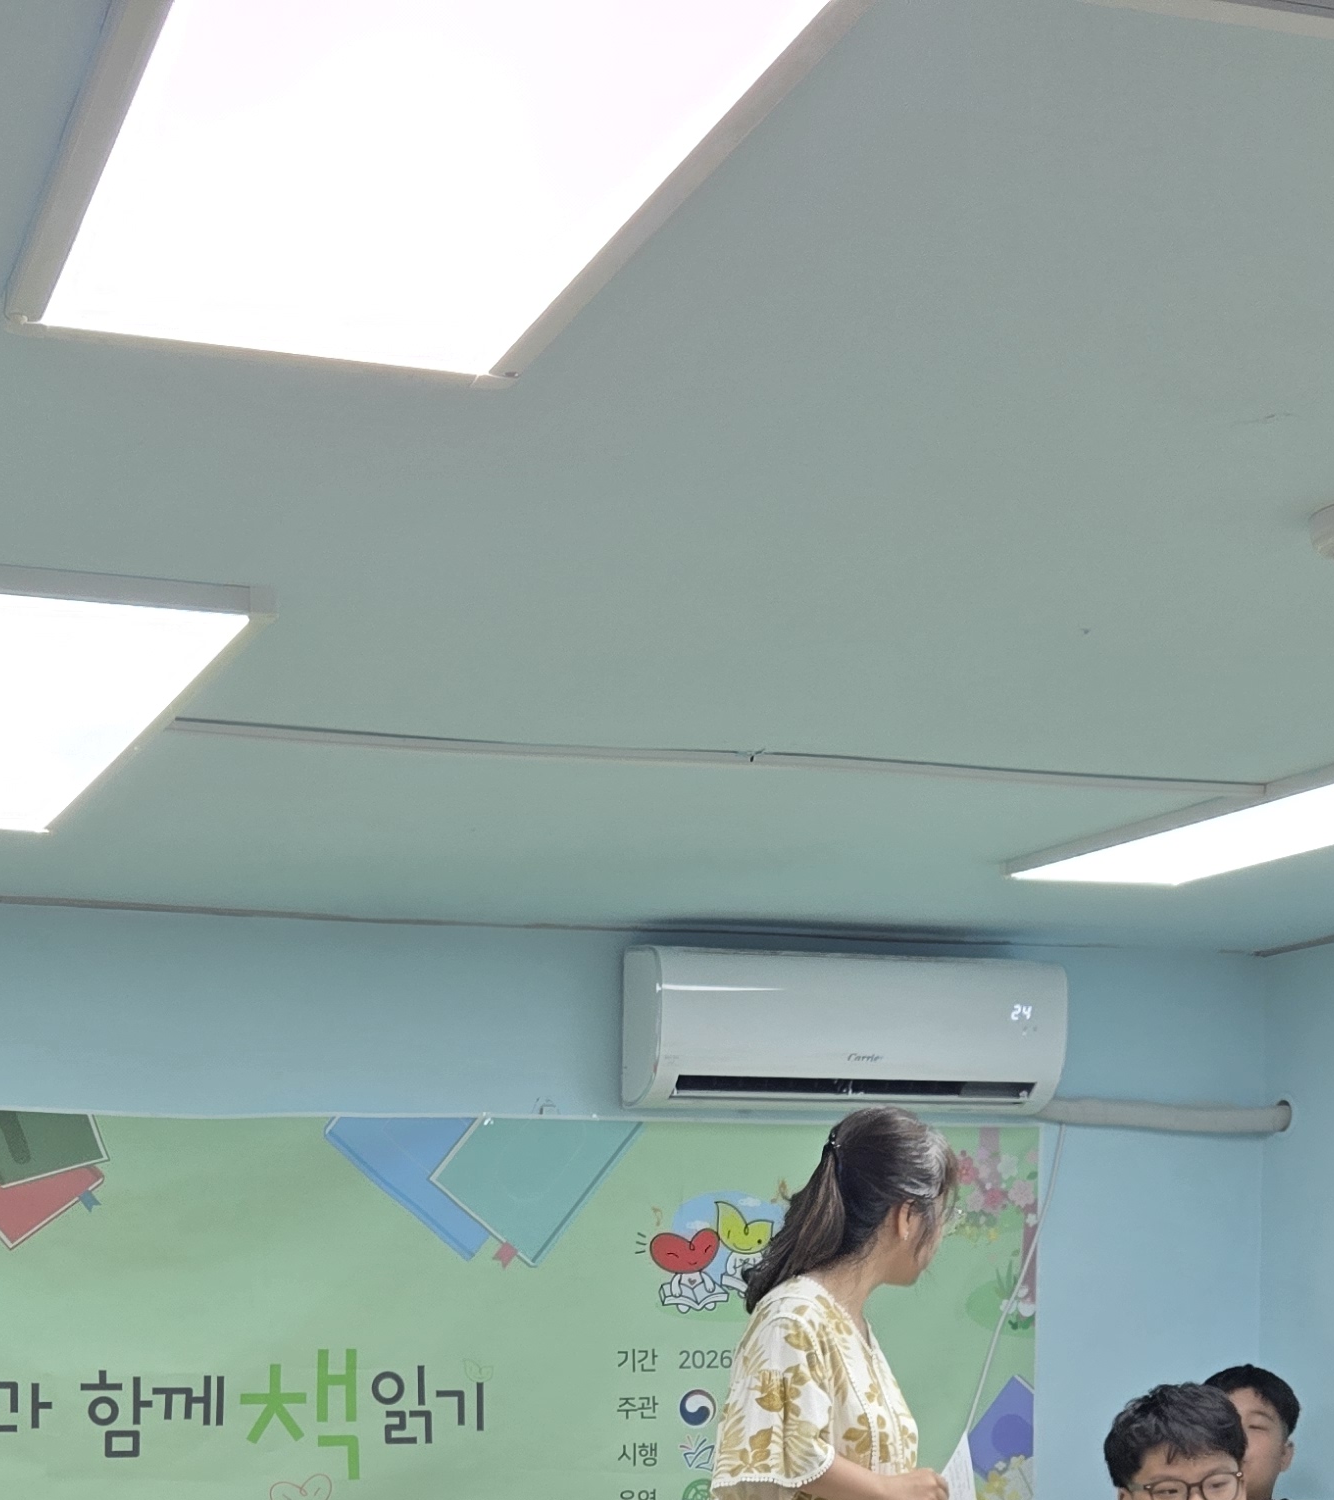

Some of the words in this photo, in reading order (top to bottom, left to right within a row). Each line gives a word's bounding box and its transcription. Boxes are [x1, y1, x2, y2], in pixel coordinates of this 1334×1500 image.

[1011, 1004, 1033, 1020] 24
[616, 1348, 659, 1373] 기간
[79, 1369, 225, 1458] 함께
[616, 1395, 659, 1420] 주관
[617, 1442, 658, 1467] 시행
